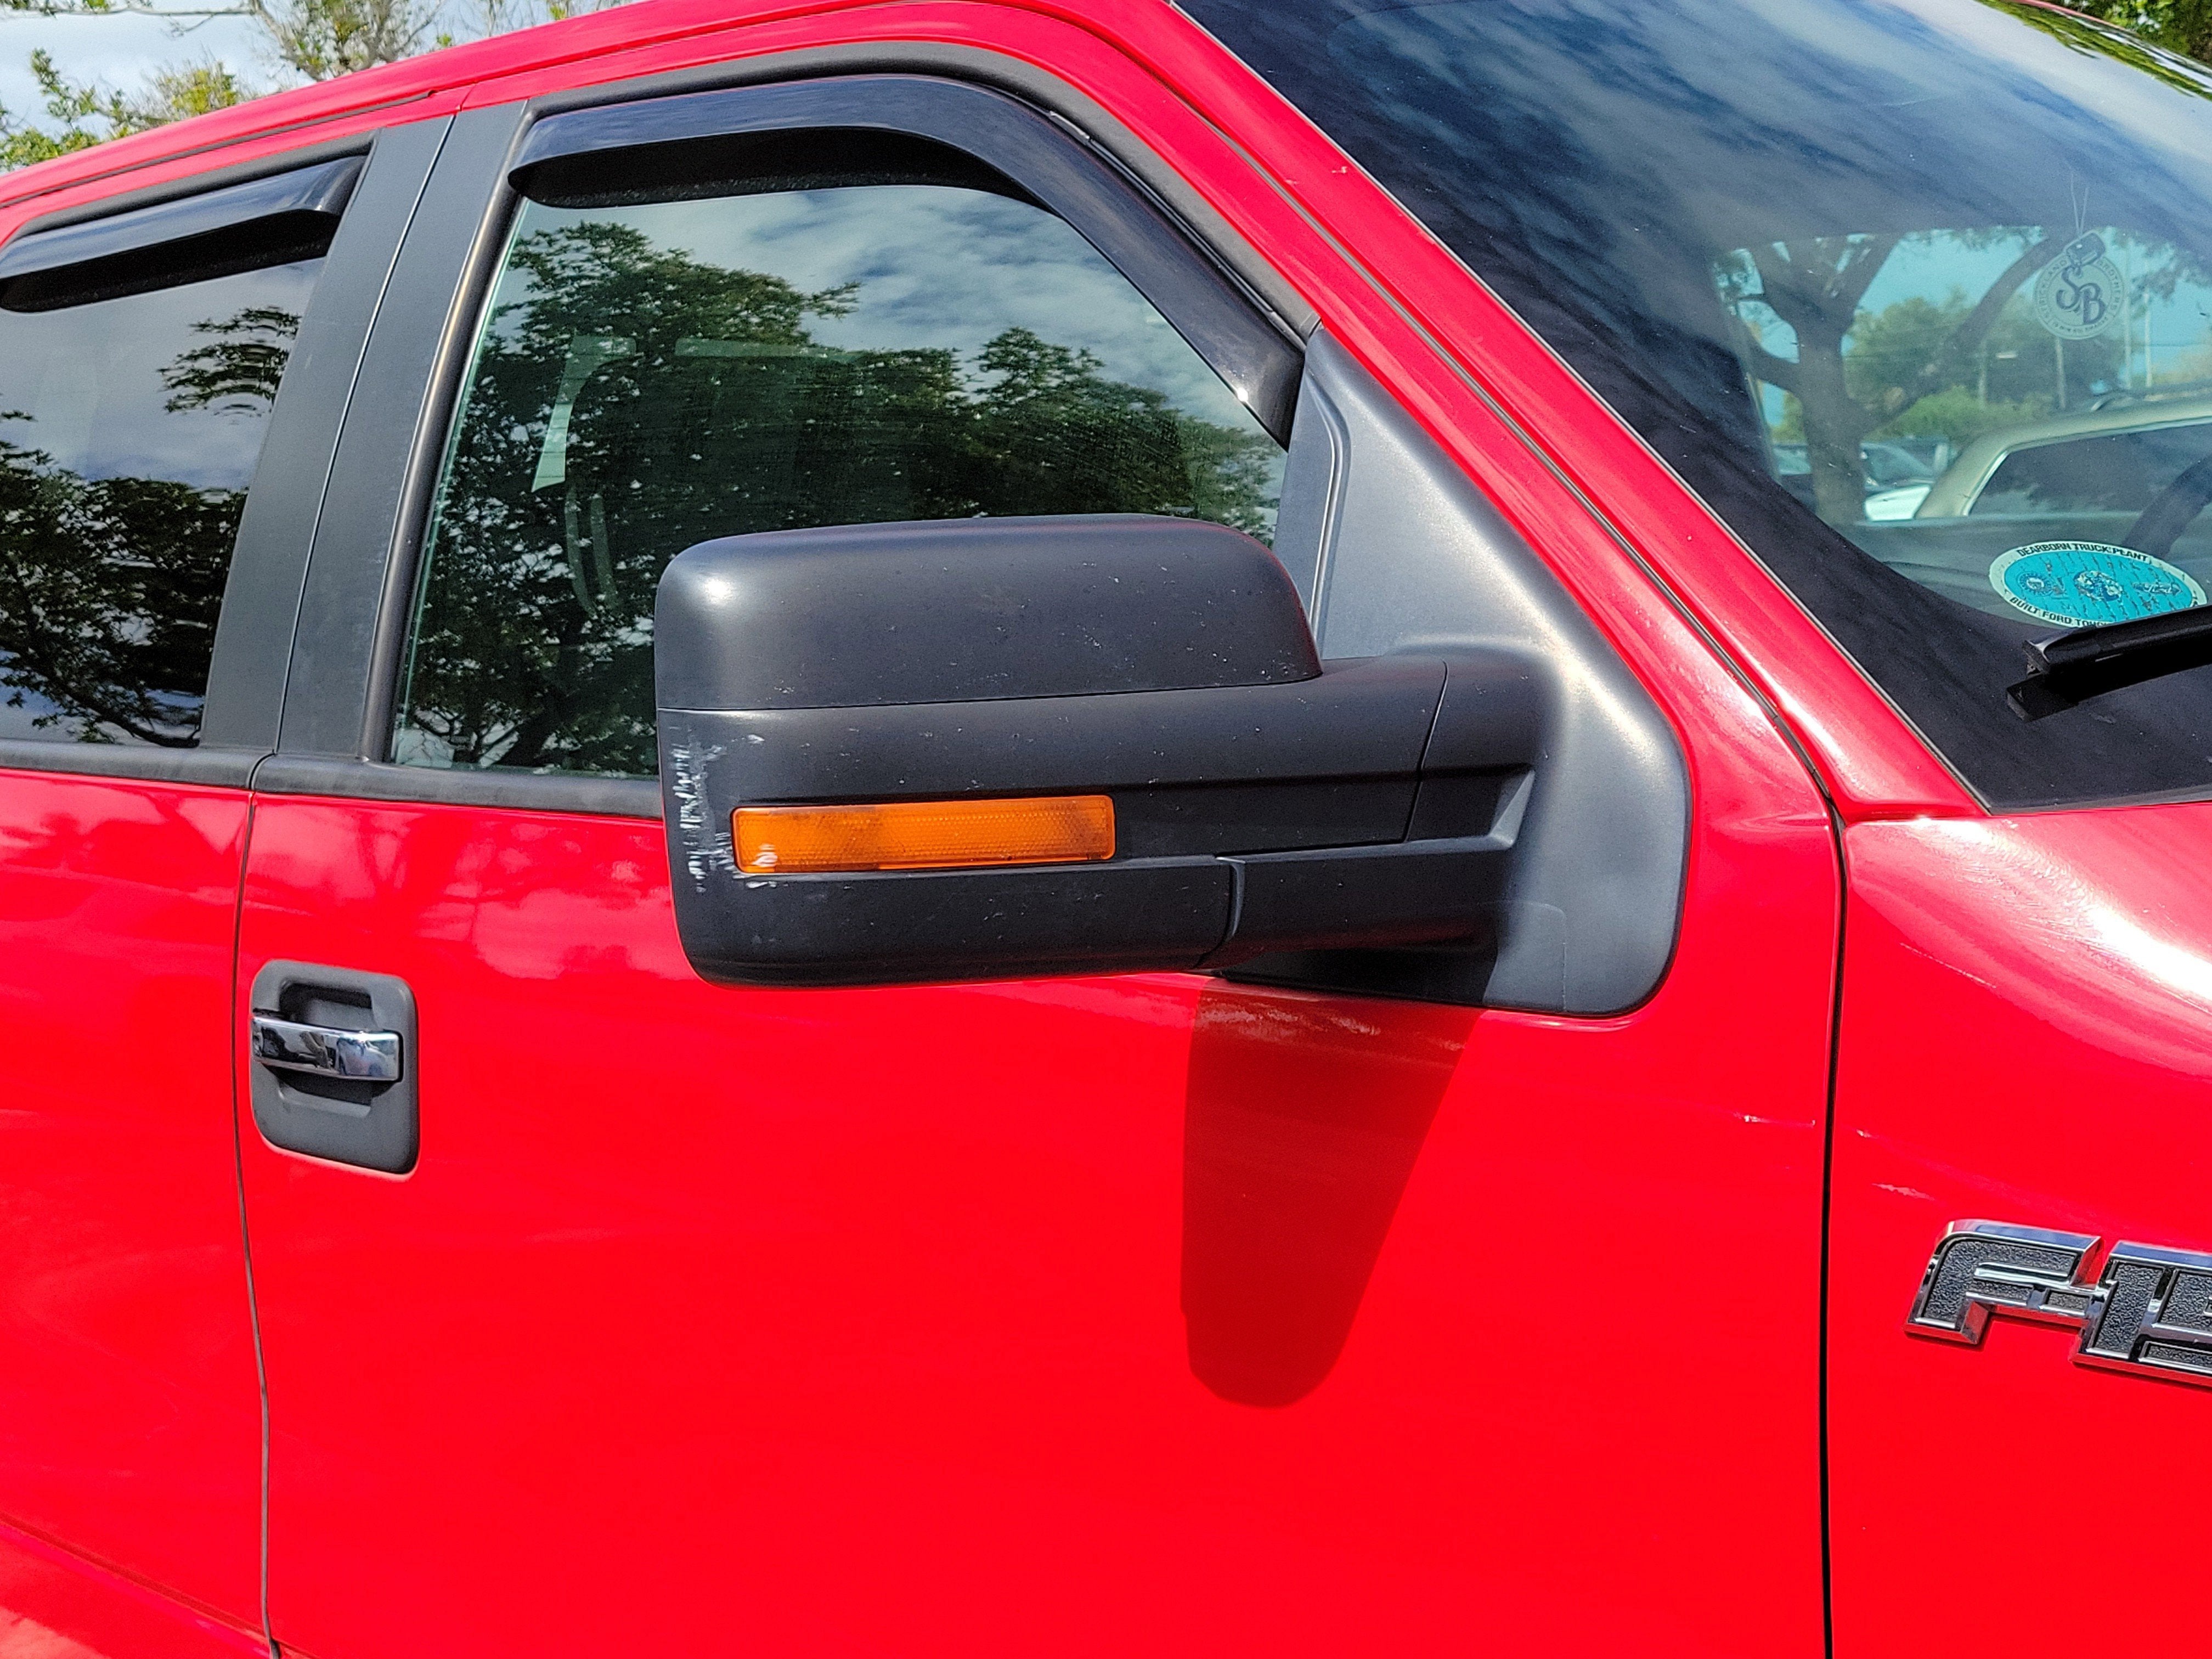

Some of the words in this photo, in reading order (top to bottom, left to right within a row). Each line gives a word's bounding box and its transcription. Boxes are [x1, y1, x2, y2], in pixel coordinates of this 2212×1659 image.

[2017, 543, 2070, 557] DEARBORN
[2071, 543, 2109, 553] TRUCK
[2112, 547, 2148, 562] PLANT
[2009, 596, 2040, 614] BUILT
[2041, 610, 2072, 624] FORD
